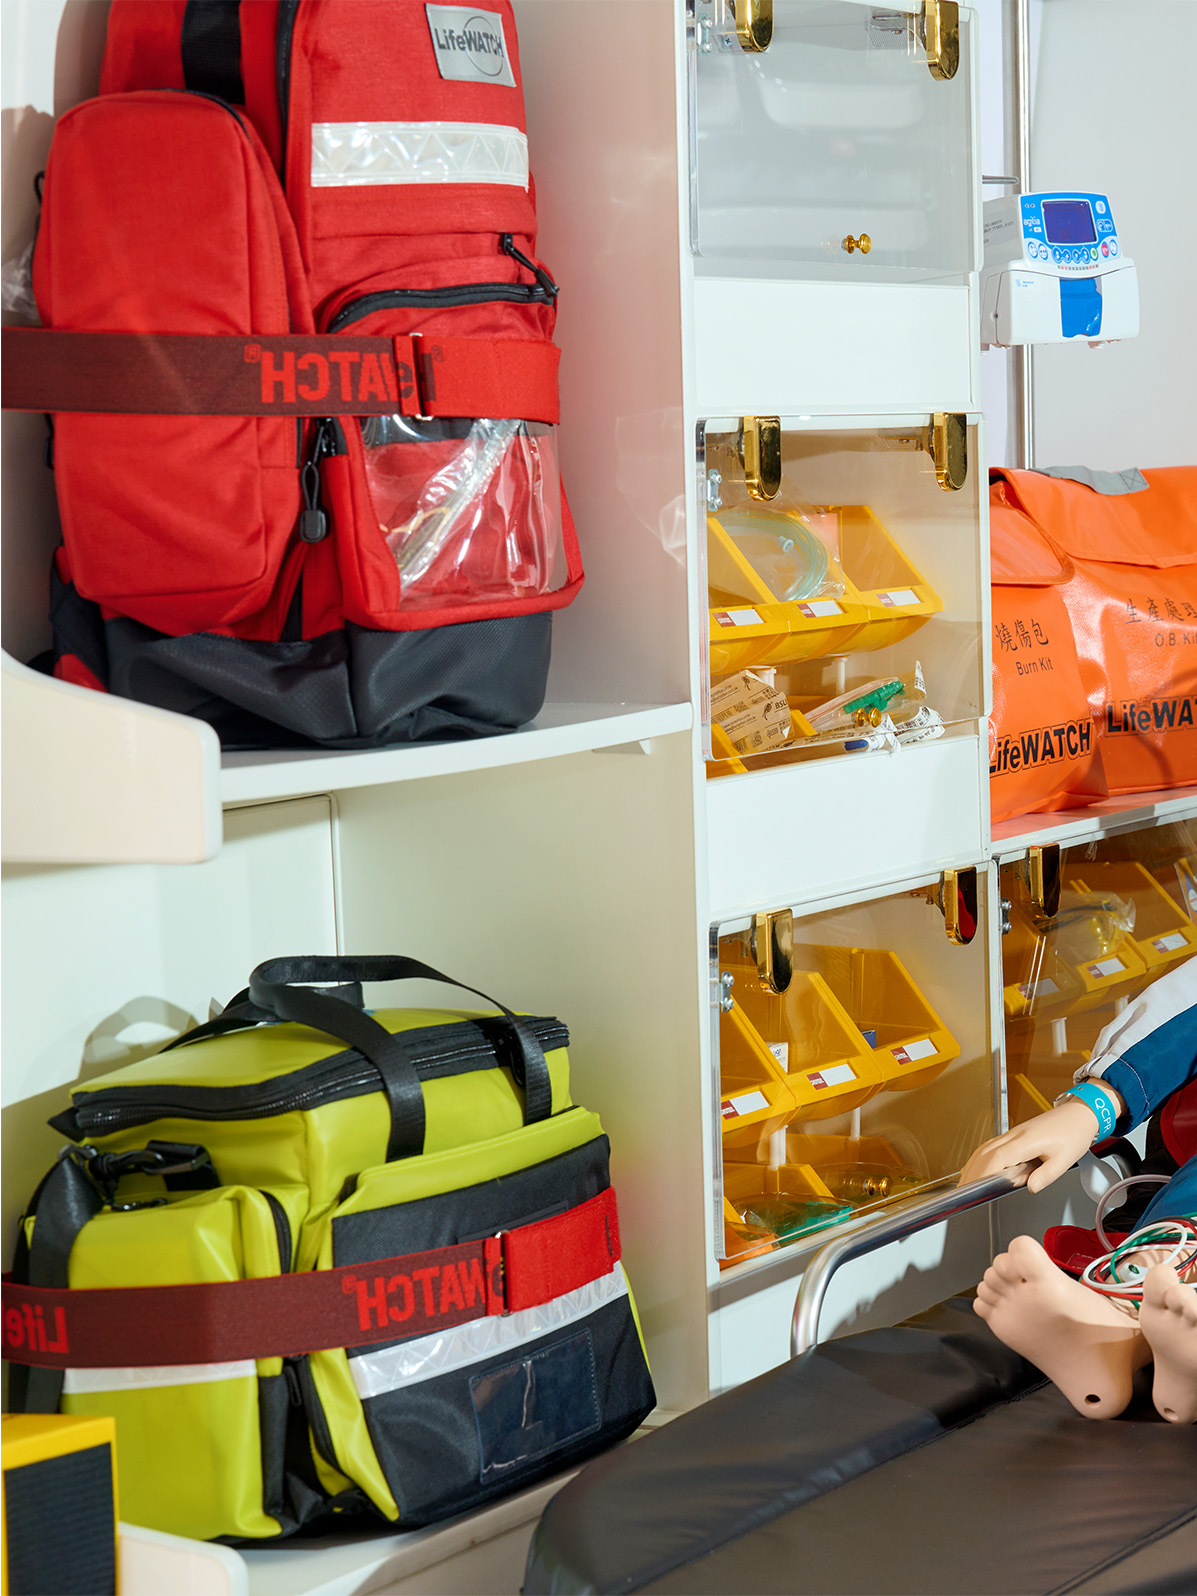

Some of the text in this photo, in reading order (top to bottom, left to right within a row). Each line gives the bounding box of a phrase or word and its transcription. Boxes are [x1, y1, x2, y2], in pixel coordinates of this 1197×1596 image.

[434, 27, 505, 58] LifeWATCH
[994, 618, 1049, 652] 燒傷包
[1015, 656, 1054, 676] Burn Kit
[1094, 1097, 1112, 1134] QCPR
